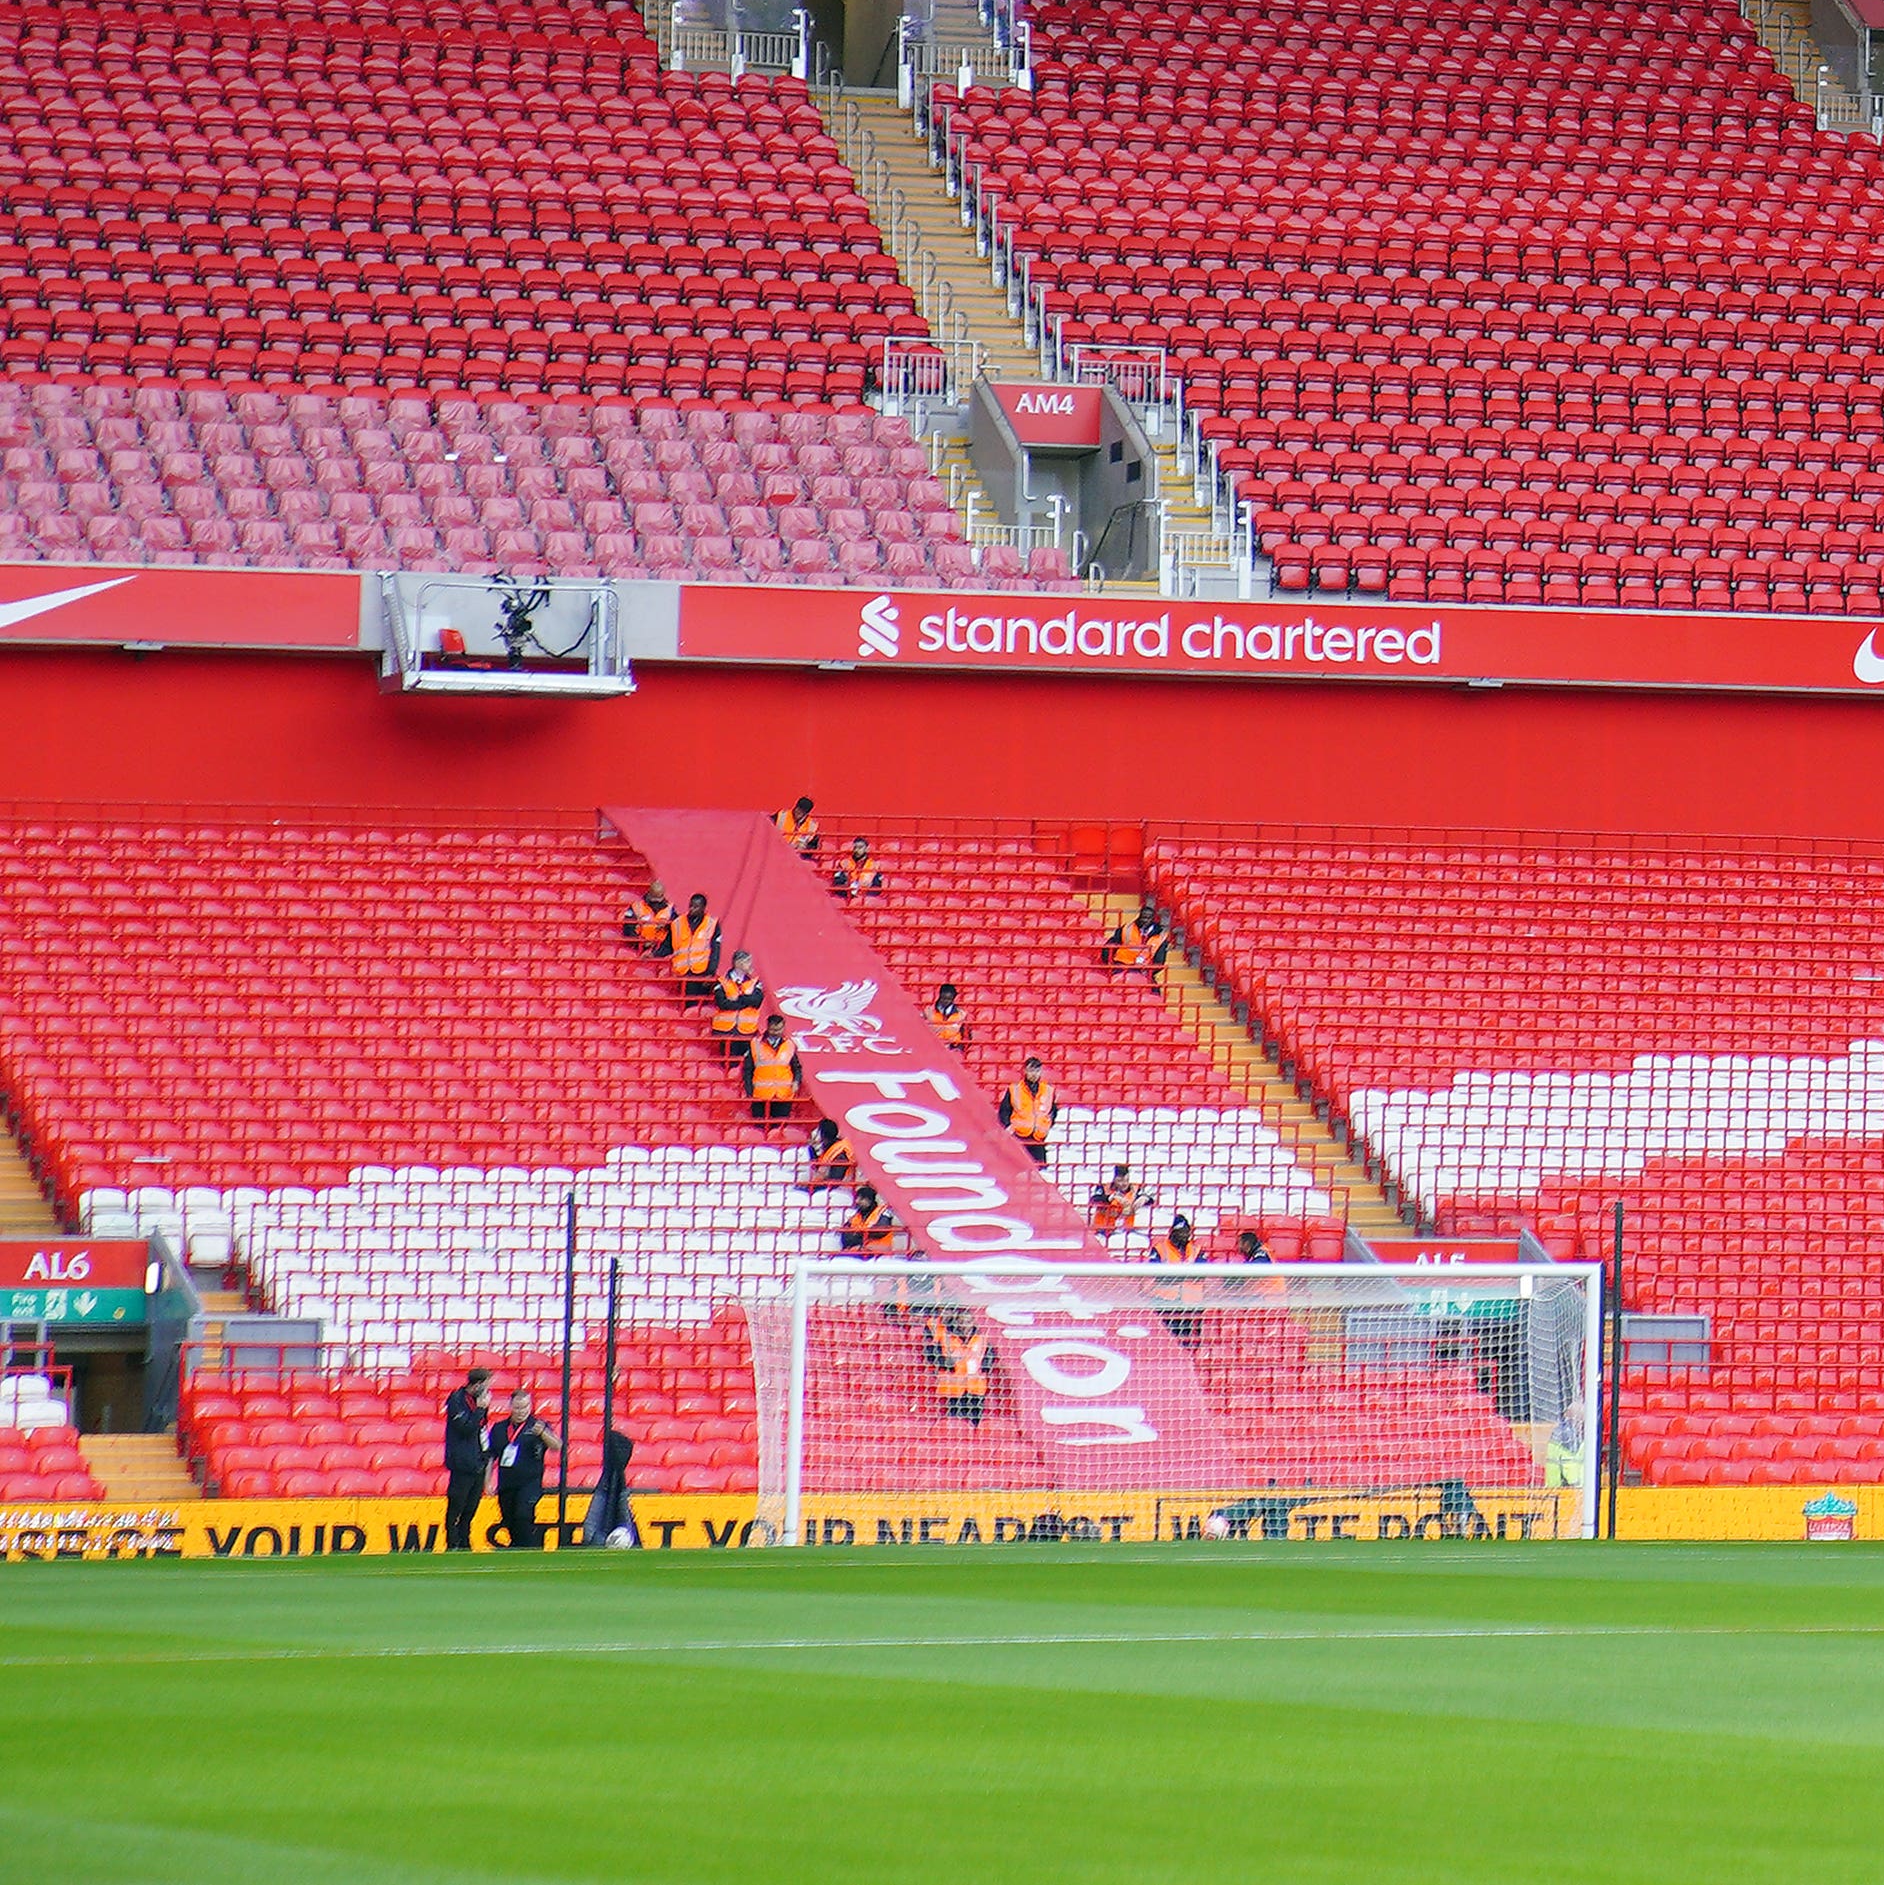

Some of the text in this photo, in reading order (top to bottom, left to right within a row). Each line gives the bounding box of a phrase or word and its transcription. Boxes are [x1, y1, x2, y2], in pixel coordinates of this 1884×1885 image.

[1015, 393, 1075, 415] AM4
[918, 607, 1441, 664] standard chartered
[22, 1250, 91, 1281] AL6
[815, 1068, 1159, 1446] Foundation
[207, 1525, 367, 1555] YOUR
